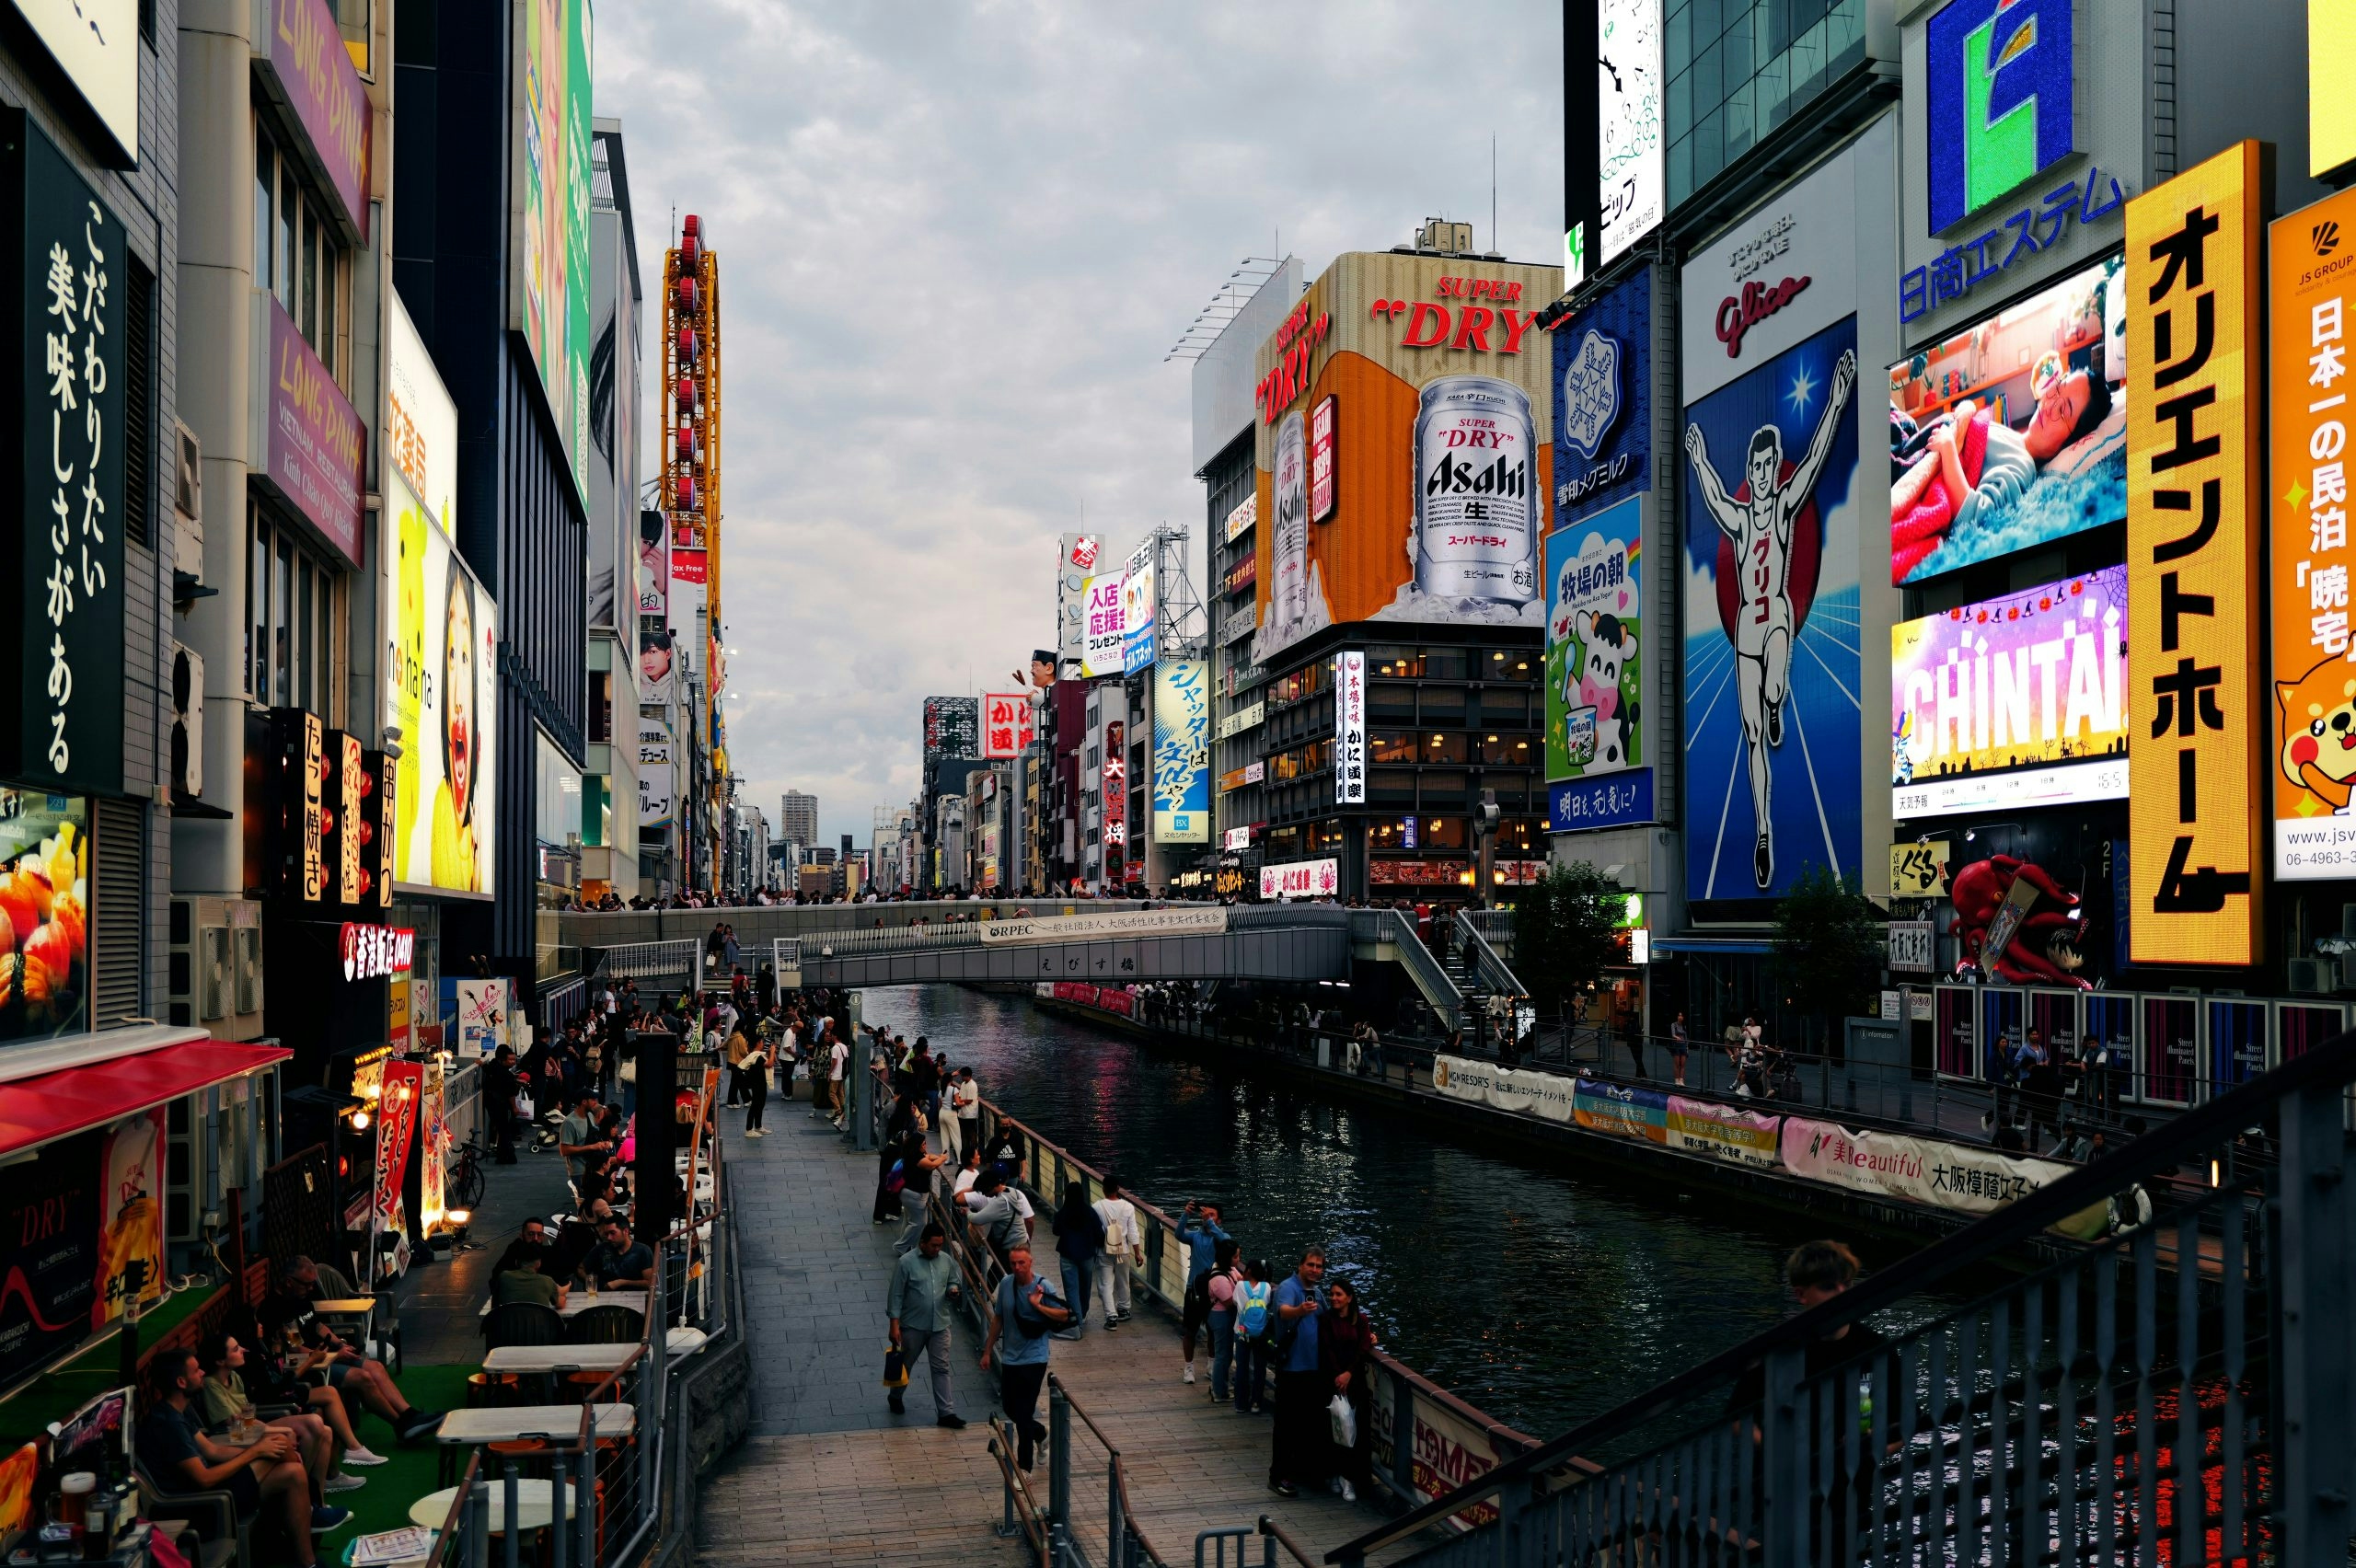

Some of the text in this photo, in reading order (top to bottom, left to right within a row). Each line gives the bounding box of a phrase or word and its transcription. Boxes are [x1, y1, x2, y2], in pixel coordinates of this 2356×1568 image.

[1900, 167, 2123, 324] 日商エステム
[2299, 256, 2353, 285] JS GROUP
[1436, 275, 1524, 302] SUPER
[1276, 301, 1308, 354] SUPER
[1715, 276, 1811, 358] Glico
[83, 201, 105, 597] こだわりたい
[280, 336, 360, 477] LONG DINH
[1313, 410, 1331, 444] ASAHI
[1459, 419, 1495, 428] SUPER
[279, 398, 359, 510] VIETNAM RESTAURANT
[1313, 447, 1331, 484] 1889
[1427, 451, 1525, 499] Asahi
[1558, 453, 1628, 506] 雪印メグミルク
[47, 241, 77, 774] 美味しさがある
[1276, 481, 1303, 539] Asahi
[1313, 479, 1331, 517] OSAKA
[1464, 502, 1489, 520] 生
[1448, 535, 1507, 548] スーパードライ
[686, 564, 703, 572] Free
[1514, 569, 1531, 588] お酒
[1562, 551, 1623, 605] 牧場の朝
[1753, 531, 1772, 625] グリコ
[1090, 583, 1118, 611] 入店
[1347, 674, 1361, 798] 本場の味 かに道楽
[1900, 794, 1928, 810] 天気予報
[381, 761, 394, 904] 串かつ
[1176, 819, 1187, 827] BX
[357, 925, 412, 979] 香港飯店 0410
[1891, 929, 1927, 963] 大阪に乾杯
[1042, 957, 1134, 971] えびす橋
[1868, 1031, 1893, 1039] information
[2177, 1037, 2193, 1047] Street
[2246, 1043, 2262, 1052] Street
[1461, 1074, 1489, 1088] RESORTS
